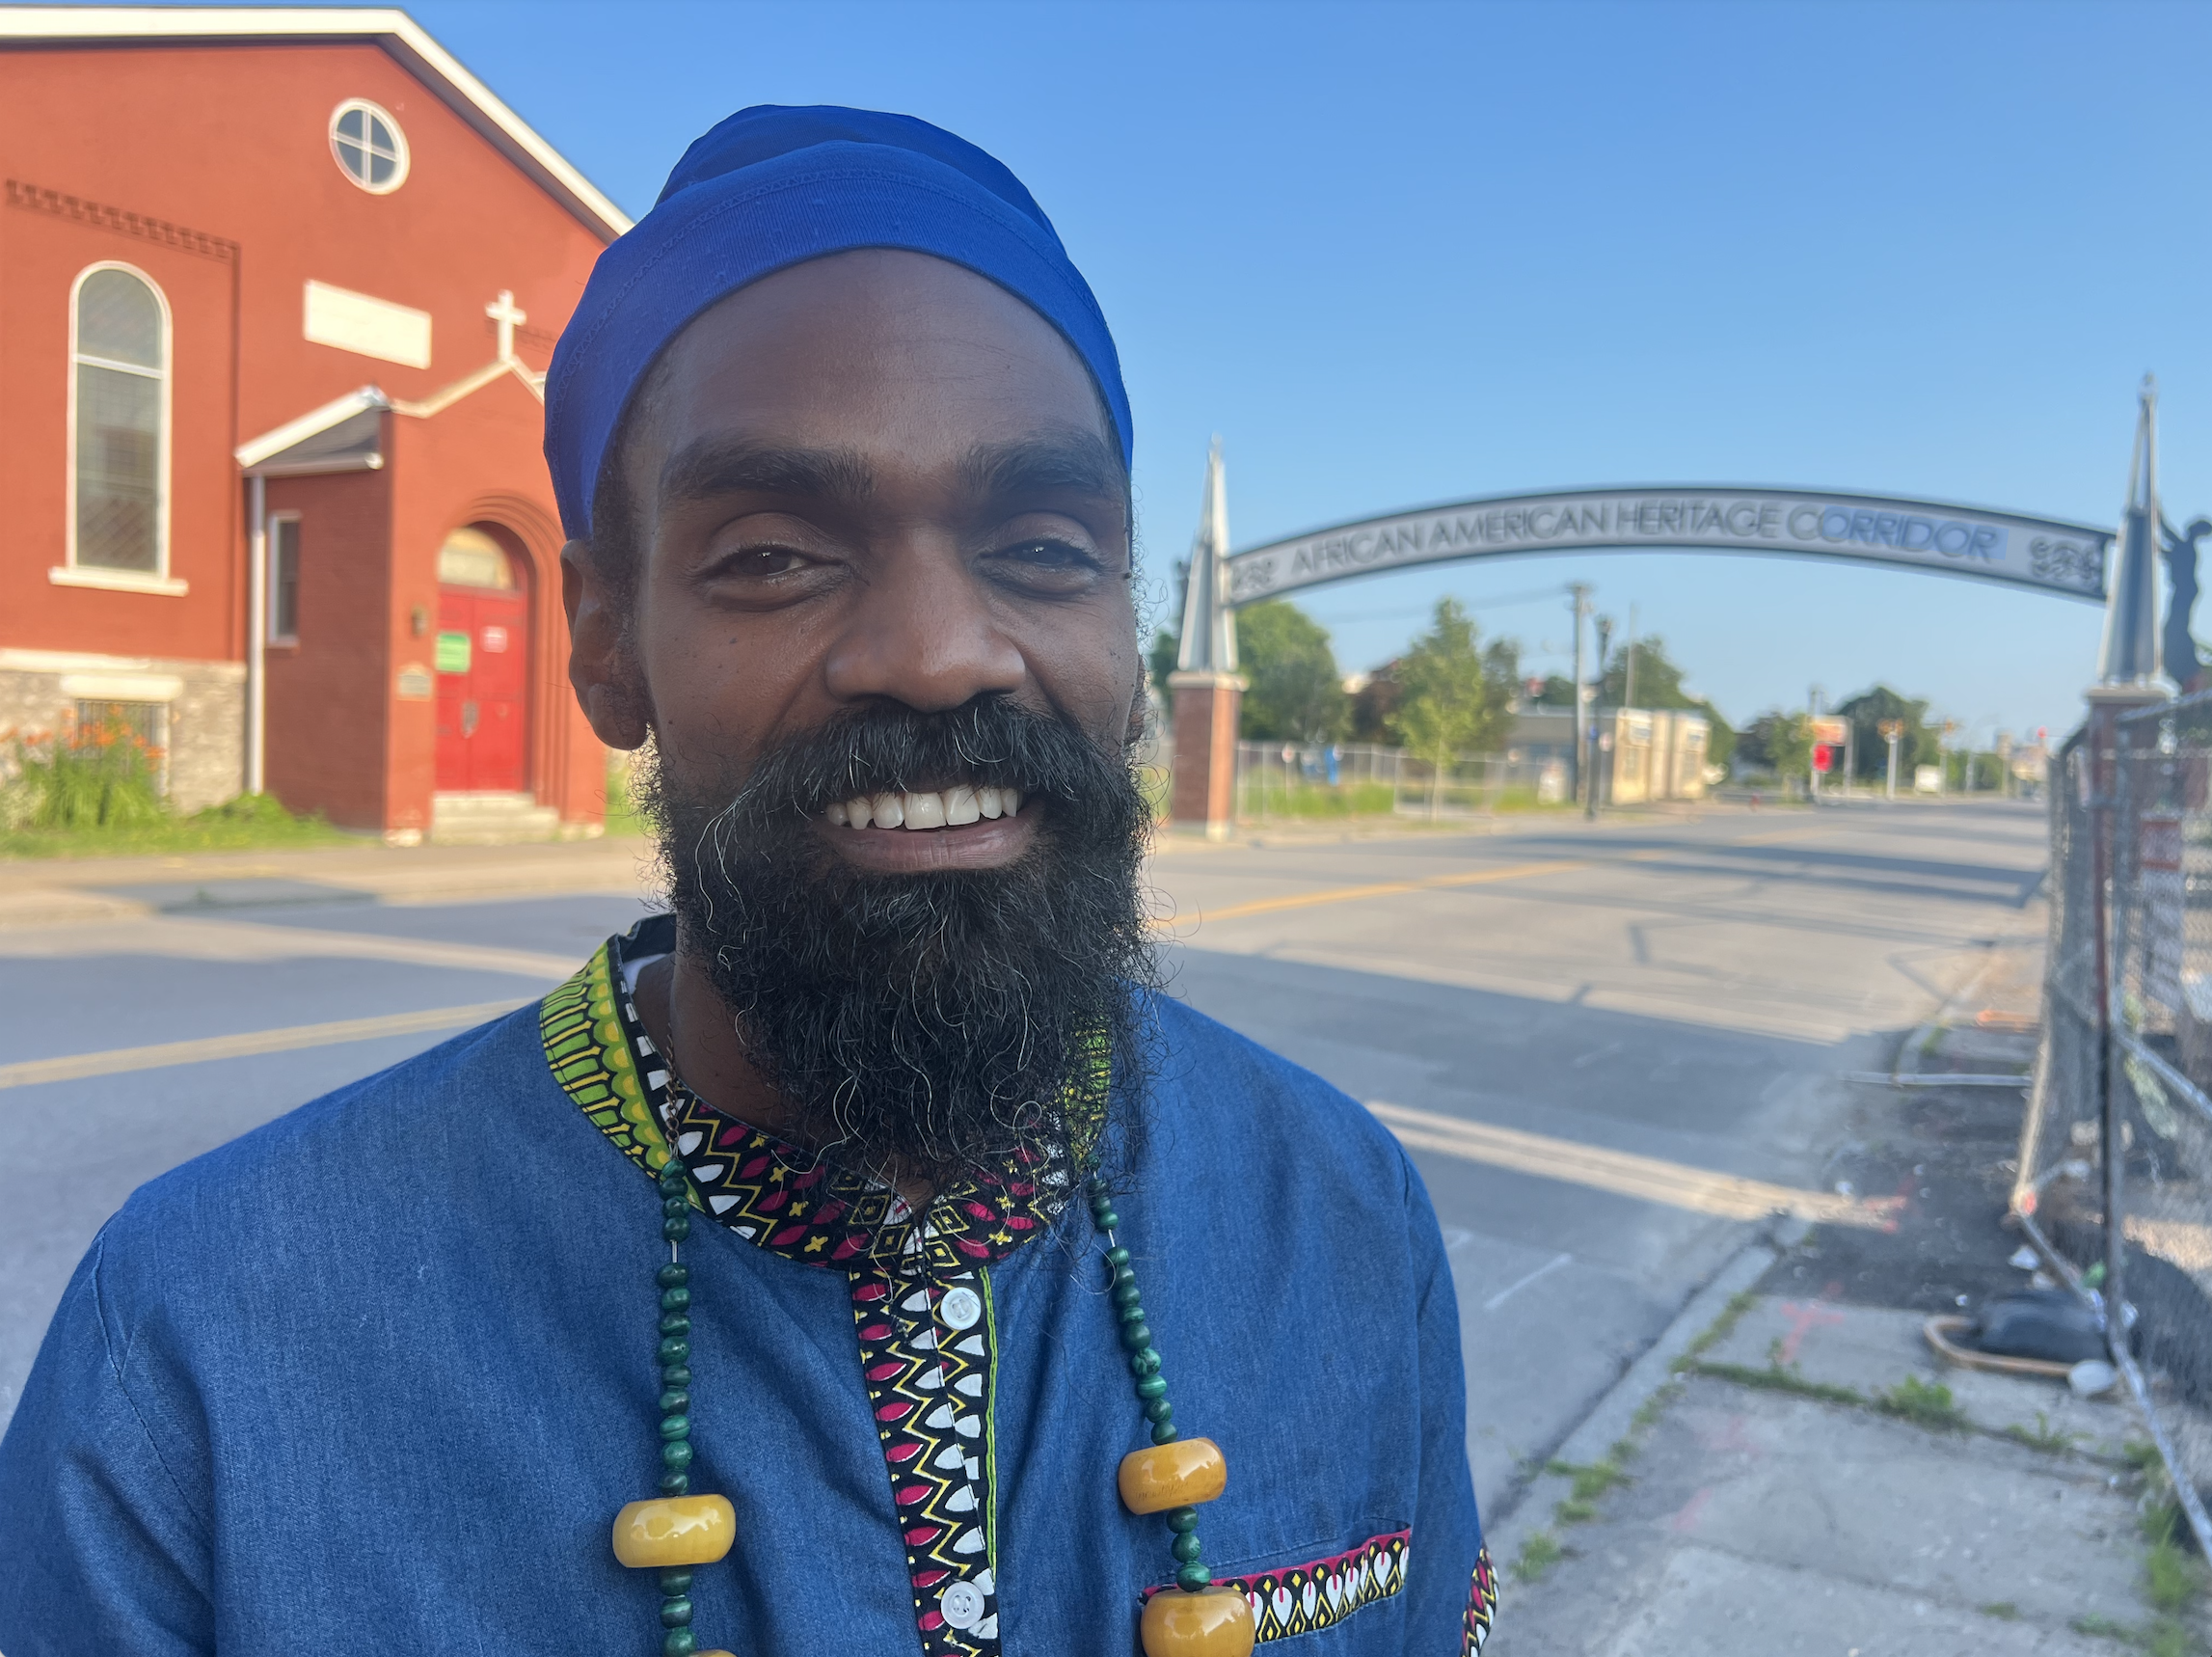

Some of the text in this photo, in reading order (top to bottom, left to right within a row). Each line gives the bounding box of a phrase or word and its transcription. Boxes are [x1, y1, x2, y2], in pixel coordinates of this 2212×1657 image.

[1290, 498, 1998, 575] AFRICAN AMERICAN HERITAGE CORRIDOR
